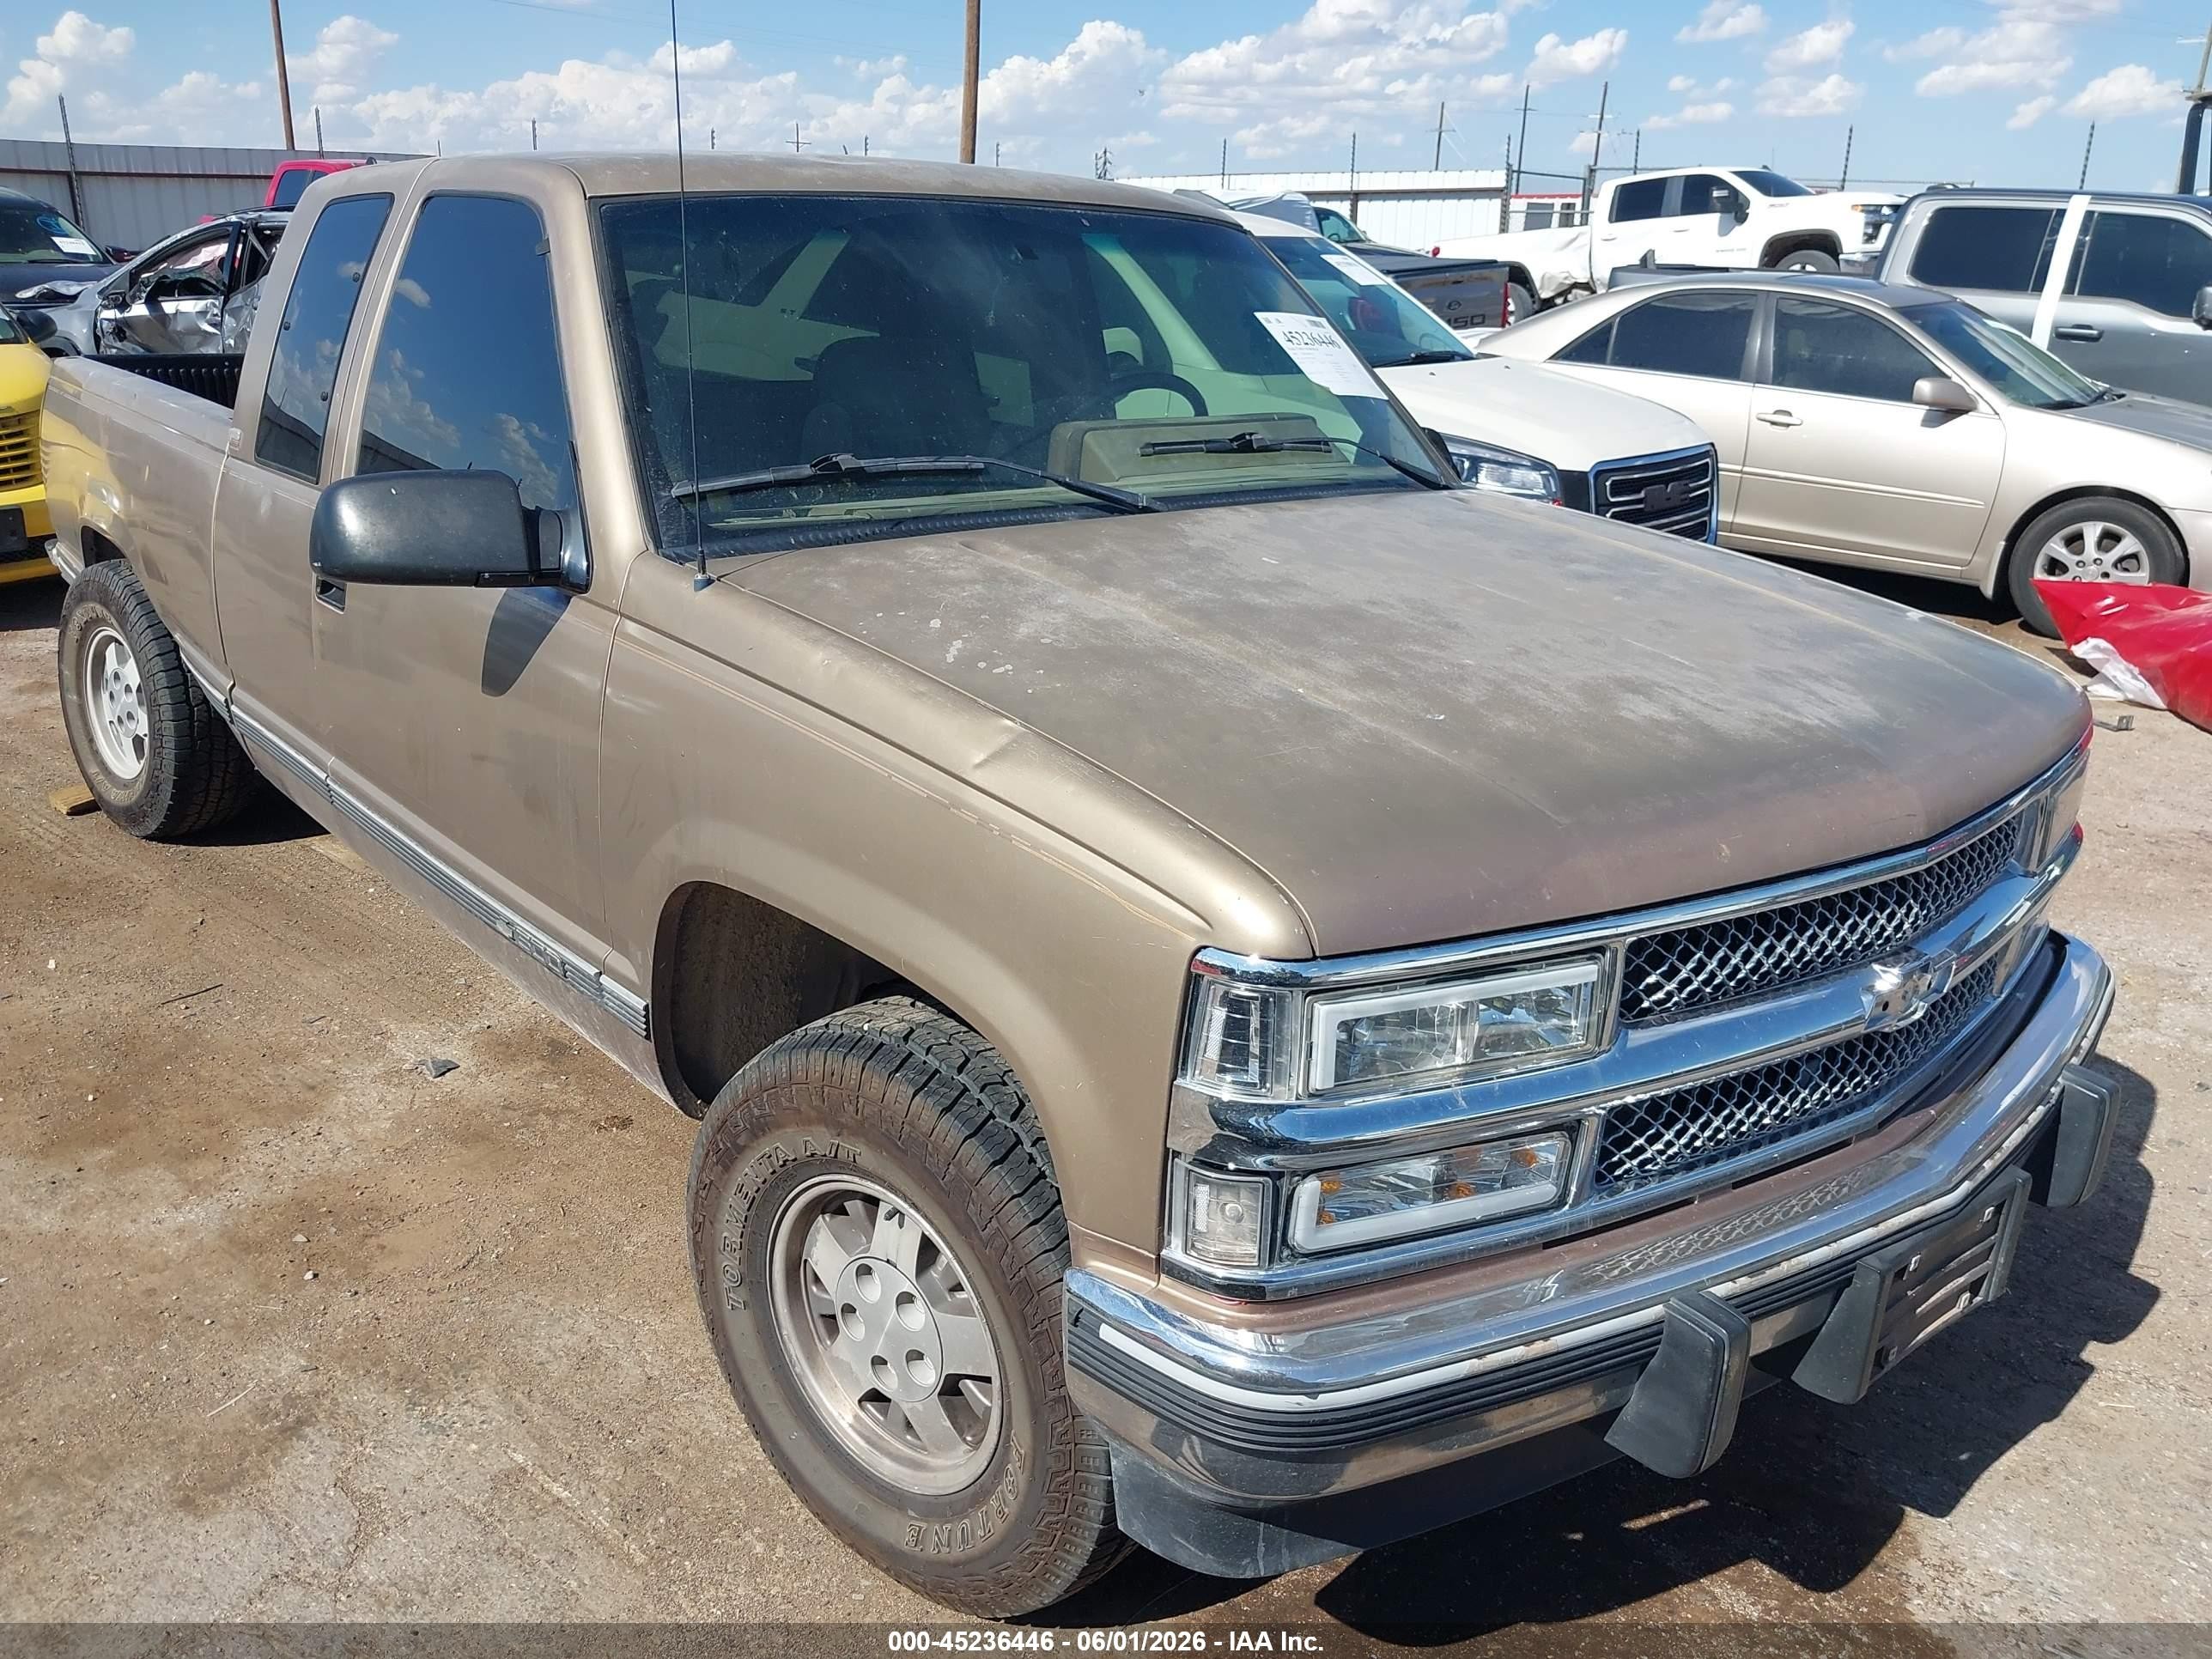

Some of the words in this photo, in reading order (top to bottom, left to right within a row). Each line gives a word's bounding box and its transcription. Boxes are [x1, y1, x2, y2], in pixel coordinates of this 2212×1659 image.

[1281, 330, 1342, 350] 45236446
[720, 1141, 798, 1311] TORMENTA
[904, 1430, 1025, 1554] FORTUNE
